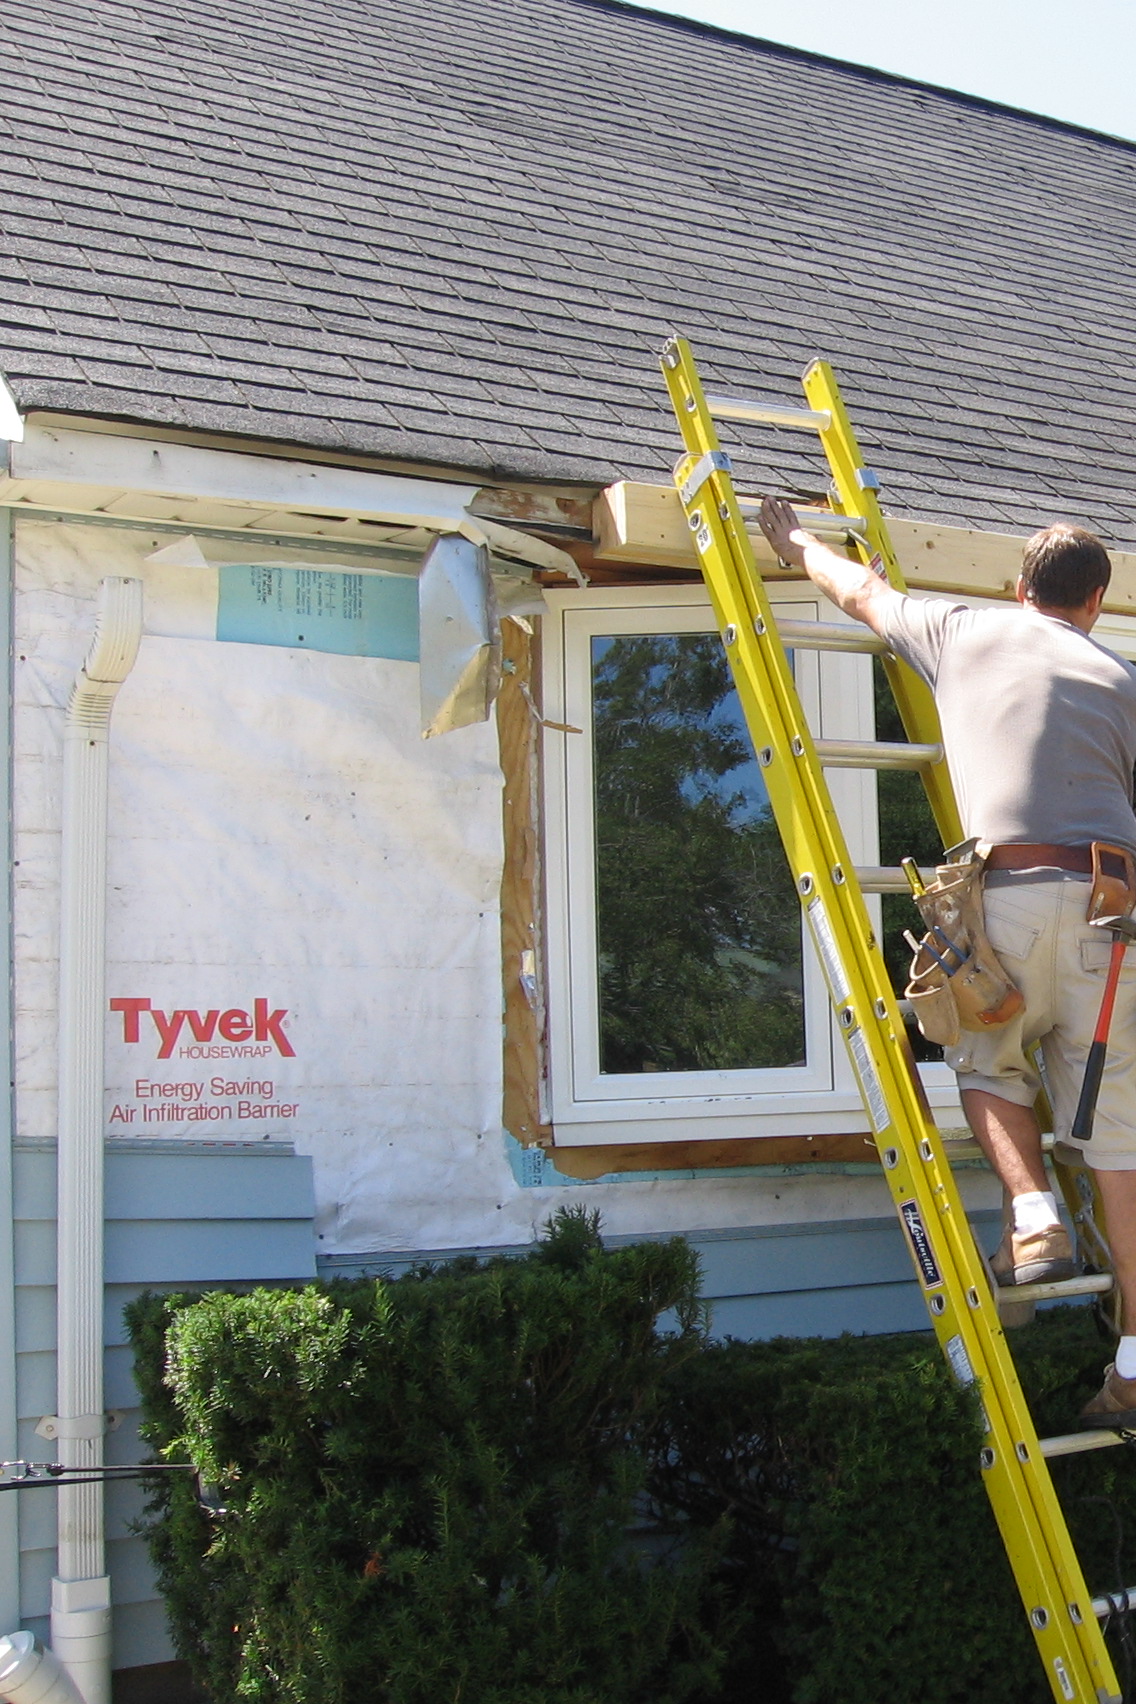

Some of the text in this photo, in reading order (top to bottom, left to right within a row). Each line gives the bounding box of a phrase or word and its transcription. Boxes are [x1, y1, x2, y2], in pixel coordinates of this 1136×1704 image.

[109, 997, 297, 1060] Tyvek
[179, 1045, 273, 1060] HOUSEWRAP
[135, 1076, 274, 1102] Energy Saving
[108, 1099, 300, 1124] Air Infiltration Barrier
